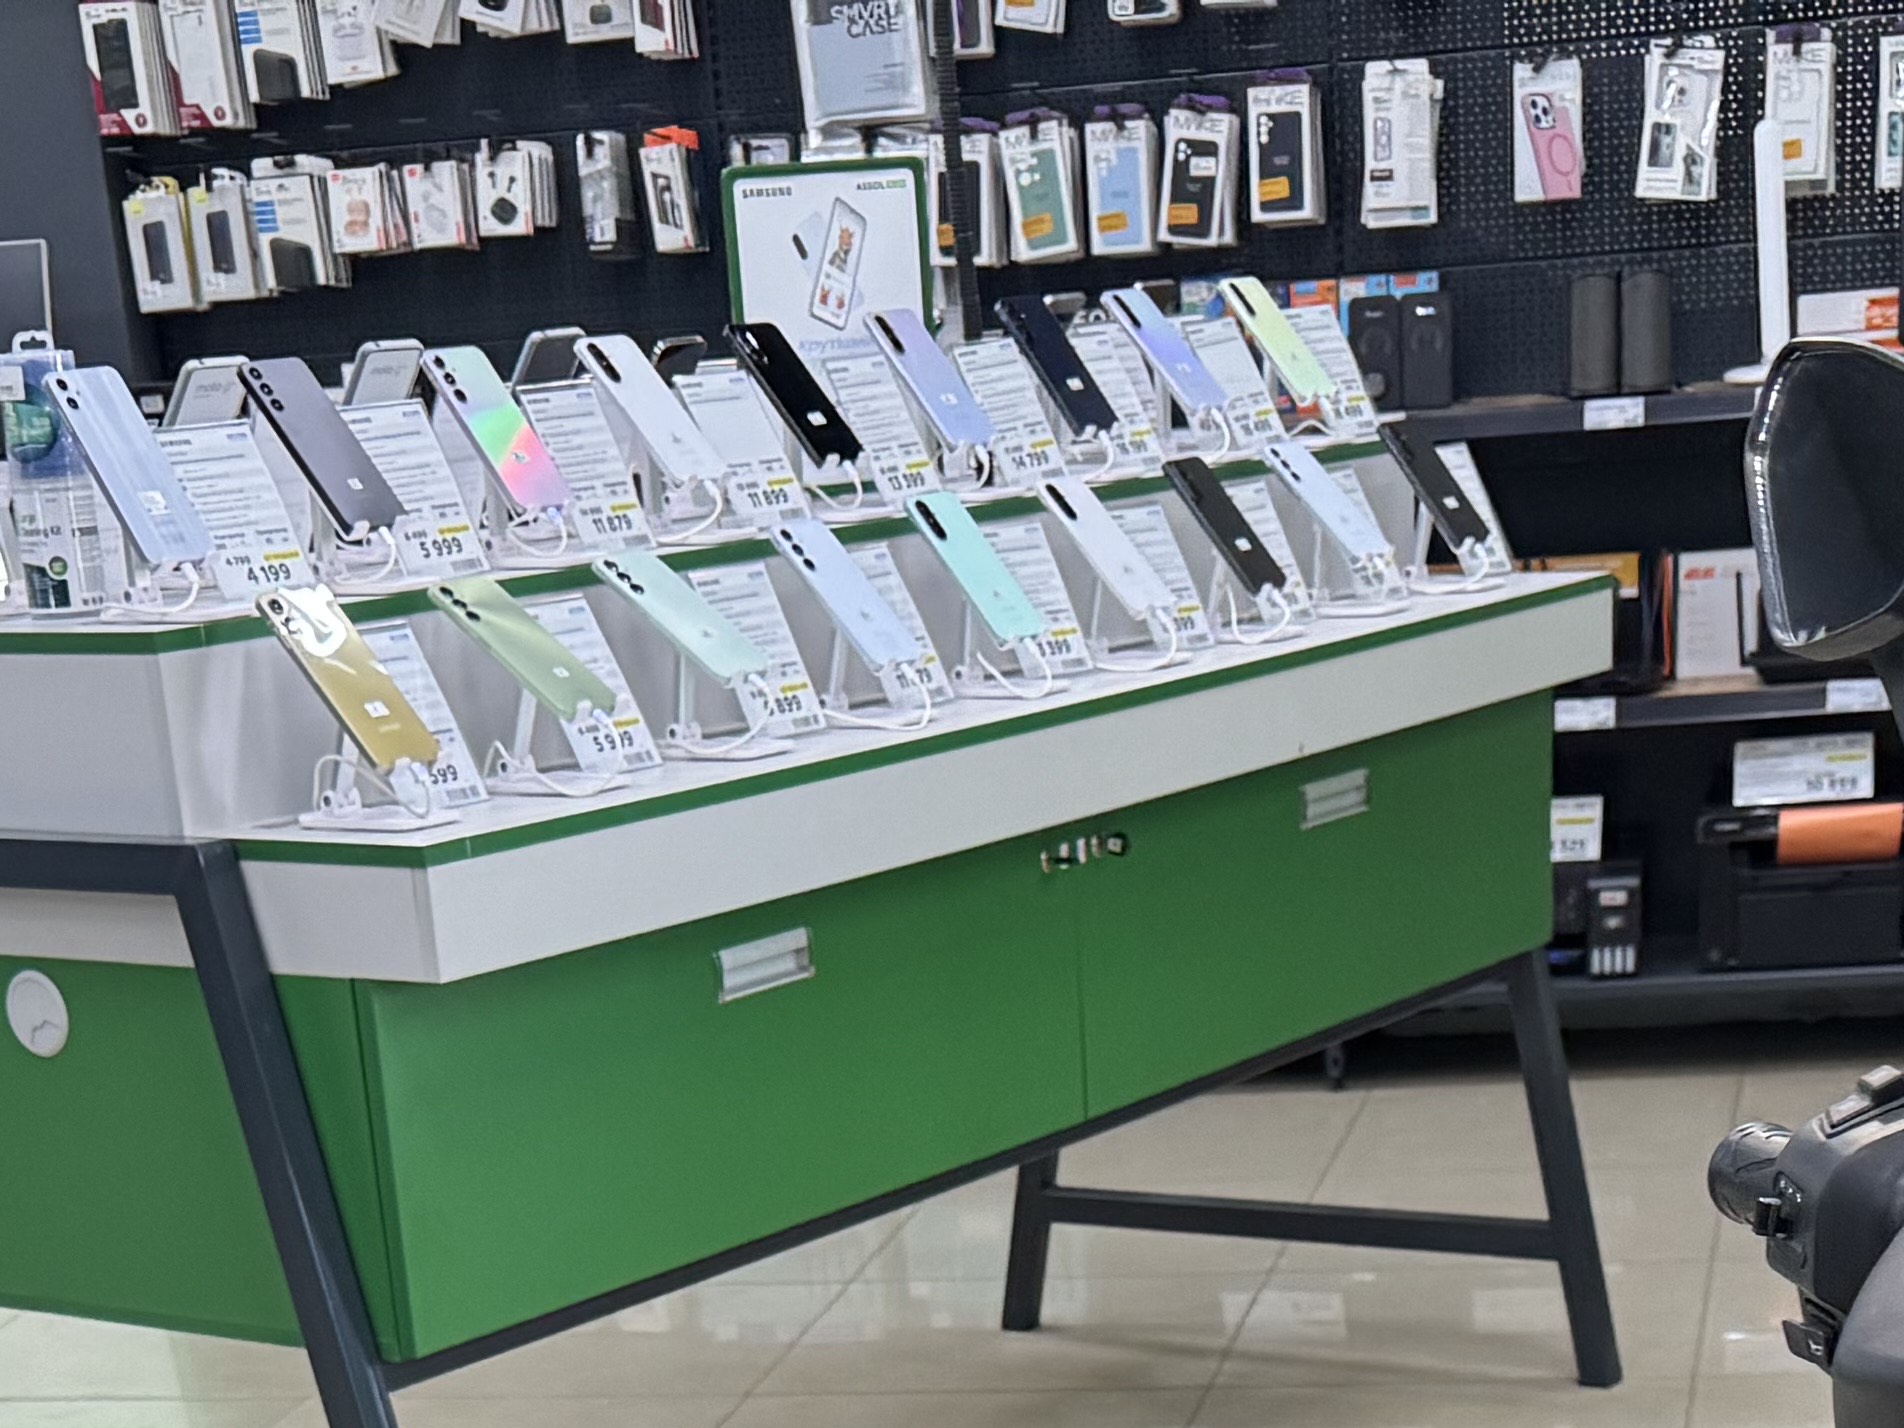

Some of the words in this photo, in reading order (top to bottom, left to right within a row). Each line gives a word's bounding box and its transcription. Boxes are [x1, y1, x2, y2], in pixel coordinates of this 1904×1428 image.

[419, 541, 431, 558] 5
[432, 536, 464, 557] 999
[247, 566, 260, 584] 4
[260, 562, 291, 583] 199
